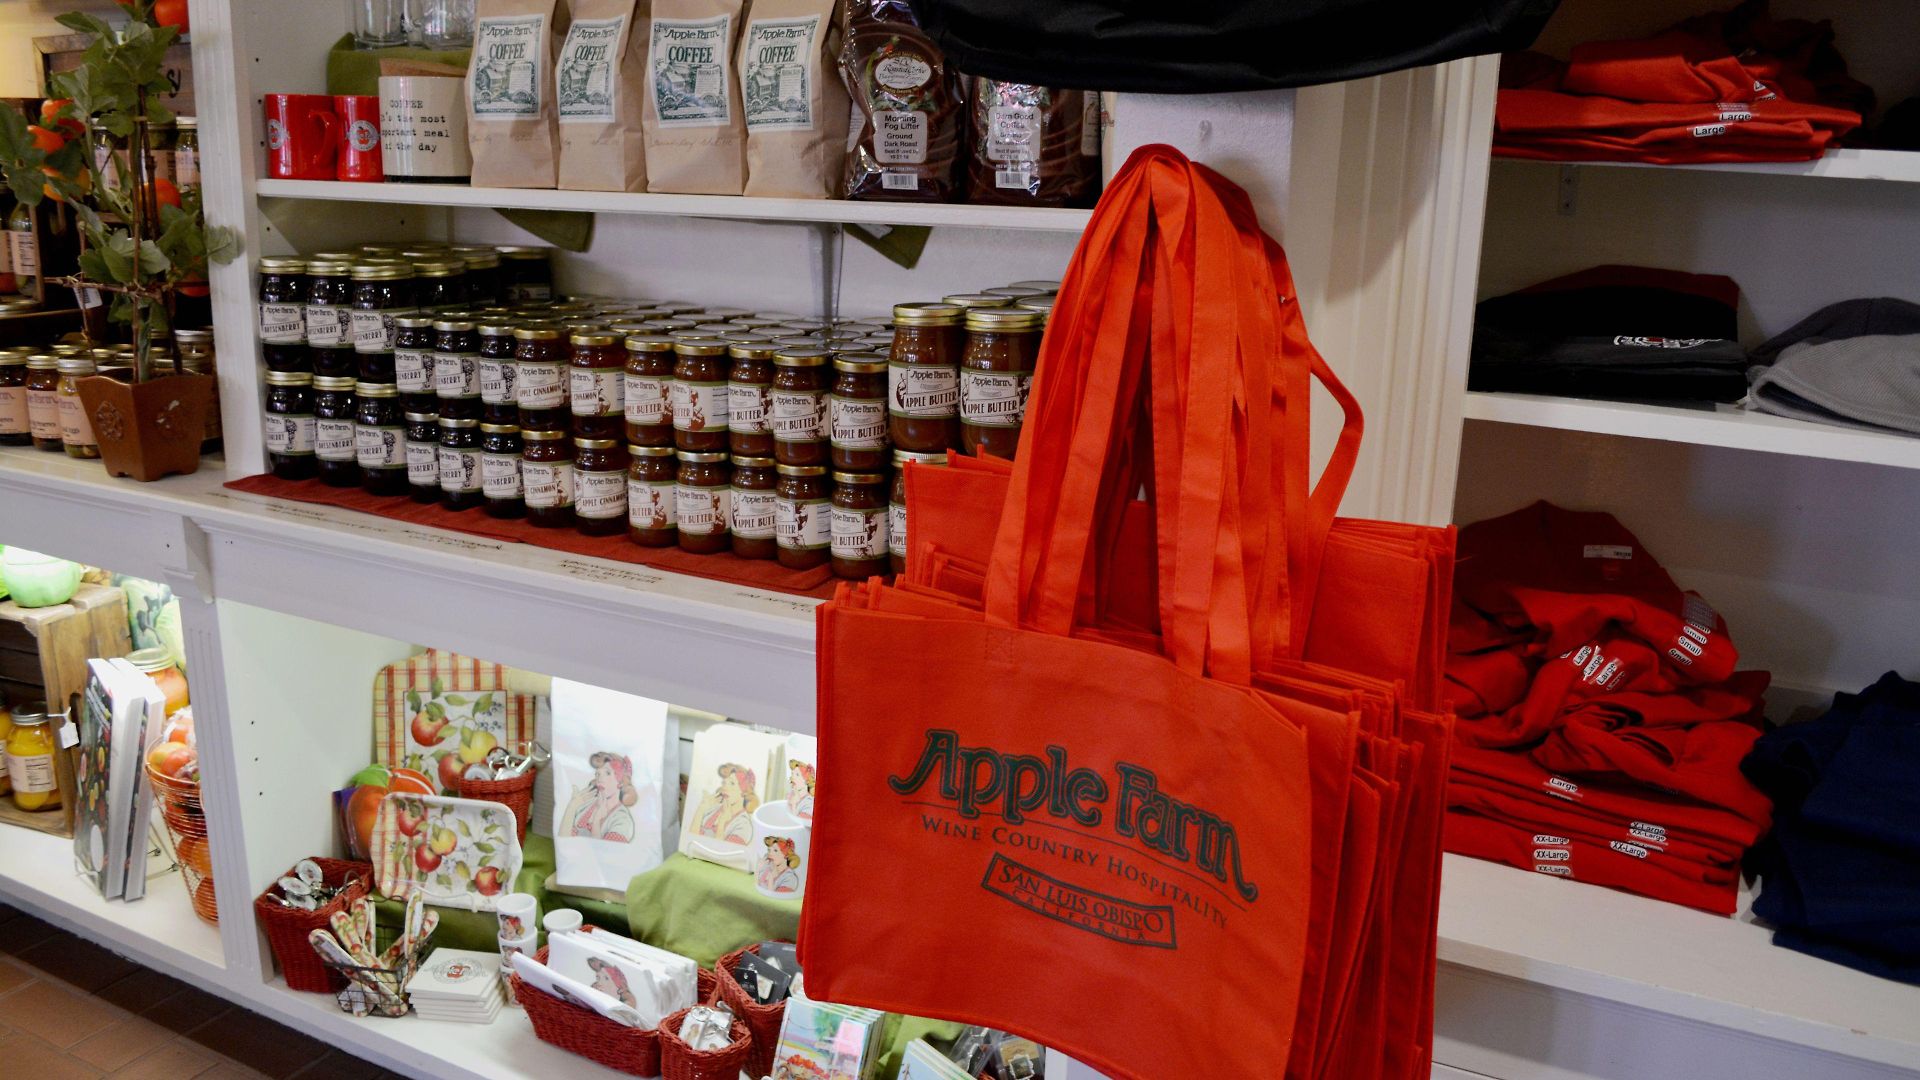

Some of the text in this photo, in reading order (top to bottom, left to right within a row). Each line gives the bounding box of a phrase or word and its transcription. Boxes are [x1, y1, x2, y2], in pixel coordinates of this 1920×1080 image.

[664, 28, 696, 40] Apple
[758, 28, 784, 40] Apple
[489, 42, 525, 60] COFFEE
[574, 44, 608, 61] COFFEE
[668, 46, 714, 64] COFFEE
[759, 45, 797, 64] COFFEE
[420, 115, 447, 123] most
[885, 115, 917, 123] Morning
[994, 112, 1033, 120] Darn Good
[1720, 113, 1751, 121] Large
[884, 123, 899, 131] Fog
[1694, 126, 1725, 136] Large
[424, 129, 450, 138] meal
[418, 142, 437, 153] day
[911, 371, 953, 380] Apple Farm
[971, 377, 1013, 387] Apple Farm
[533, 383, 561, 396] CINNAMON
[775, 397, 811, 406] Apple Farm
[905, 391, 957, 408] APPLE BUTTER
[636, 403, 662, 413] BUTTER
[842, 404, 880, 413] Apple Farm
[967, 400, 1017, 414] APPLE BUTTER
[736, 409, 762, 420] BUTTER
[789, 417, 817, 430] BUTTER
[838, 424, 885, 439] APPLE BUTTER
[585, 478, 605, 486] Apple
[530, 483, 556, 495] CINNAMON
[741, 495, 761, 504] Apple
[688, 513, 713, 523] BUTTER
[738, 517, 755, 528] APPLE
[839, 535, 865, 546] BUTTER
[1684, 626, 1706, 643] Small
[1679, 636, 1700, 656] Small
[1574, 646, 1591, 664] Large
[1670, 649, 1692, 665] Small
[1584, 655, 1603, 675] Large
[1597, 662, 1616, 684] Large
[1551, 778, 1577, 791] Large
[887, 728, 1259, 903] Apple Farm
[1536, 836, 1568, 844] XX-Large
[1536, 851, 1569, 861] XX-Large
[1612, 842, 1646, 858] XX-Large
[921, 814, 1228, 929] WINE COUNTRY HOSPITALITY
[1538, 866, 1569, 874] XX-Large
[999, 863, 1163, 934] SAN LUIS OBISPO
